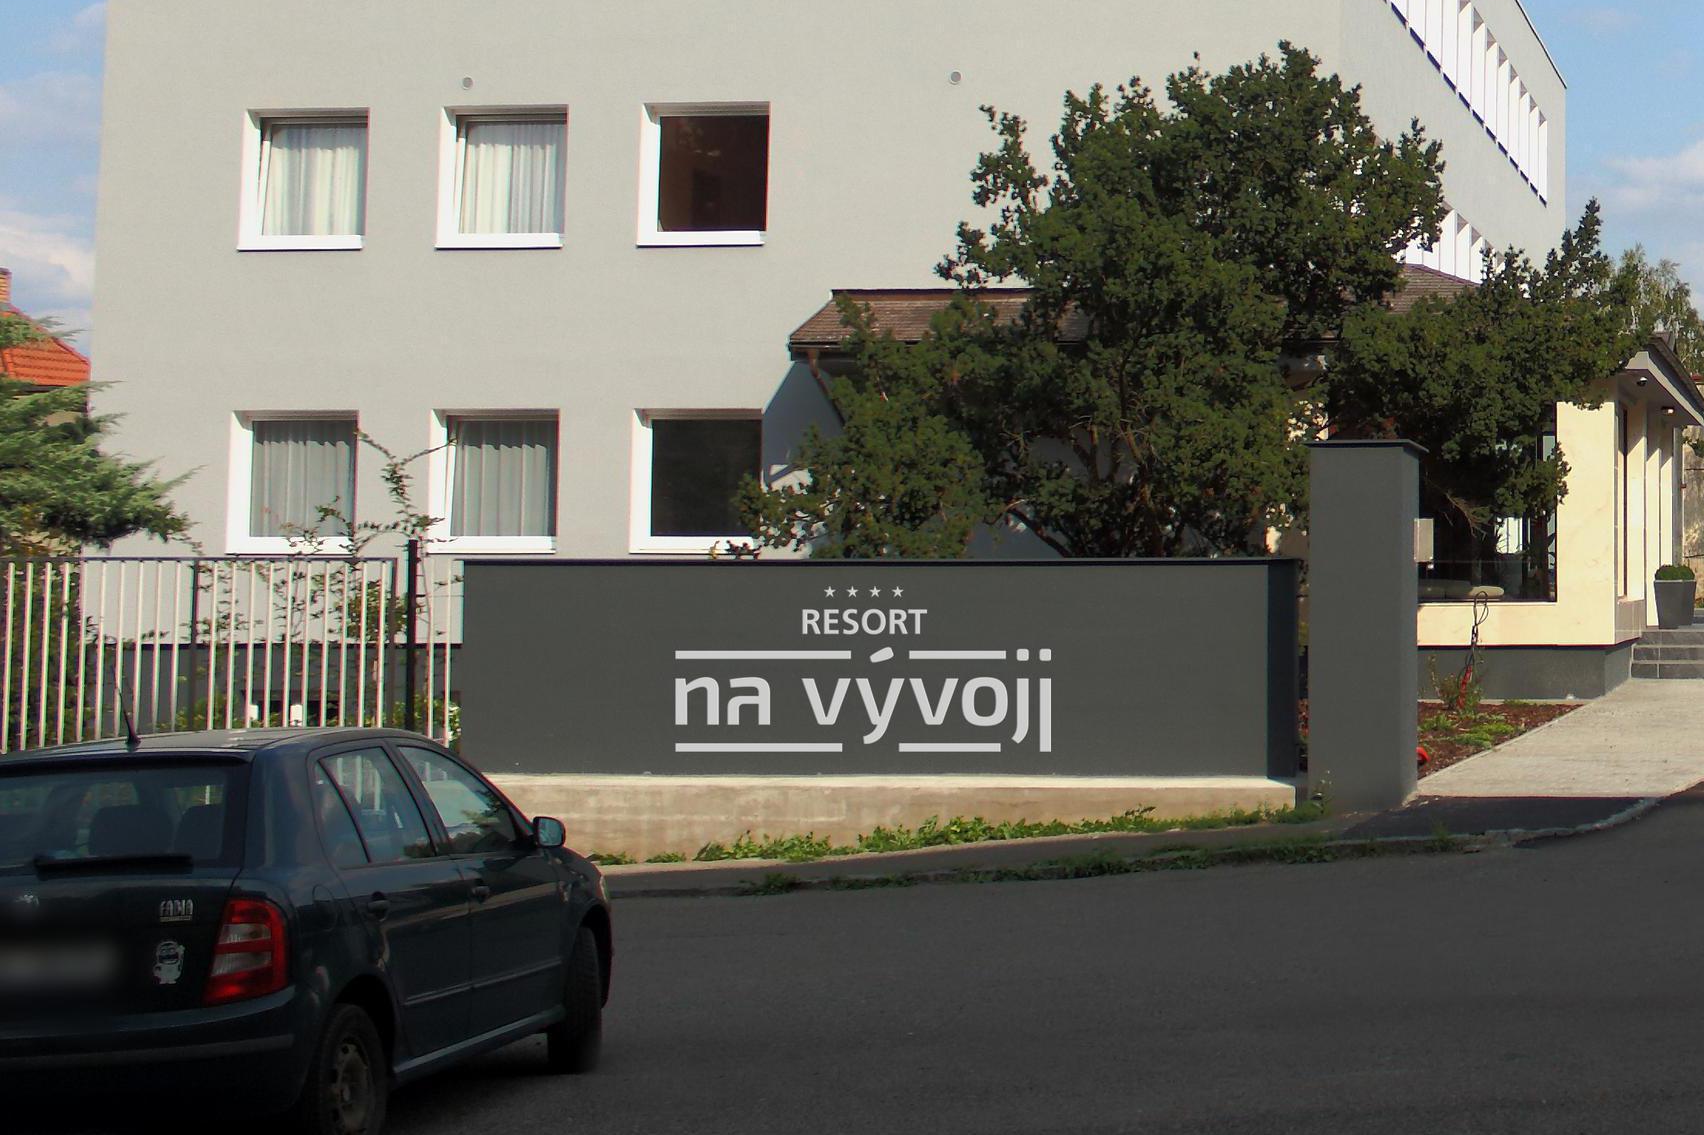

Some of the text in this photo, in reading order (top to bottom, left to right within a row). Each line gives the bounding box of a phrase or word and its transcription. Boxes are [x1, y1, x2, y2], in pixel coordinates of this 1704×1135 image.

[801, 608, 928, 635] RESORT
[674, 646, 1052, 753] na vývoji
